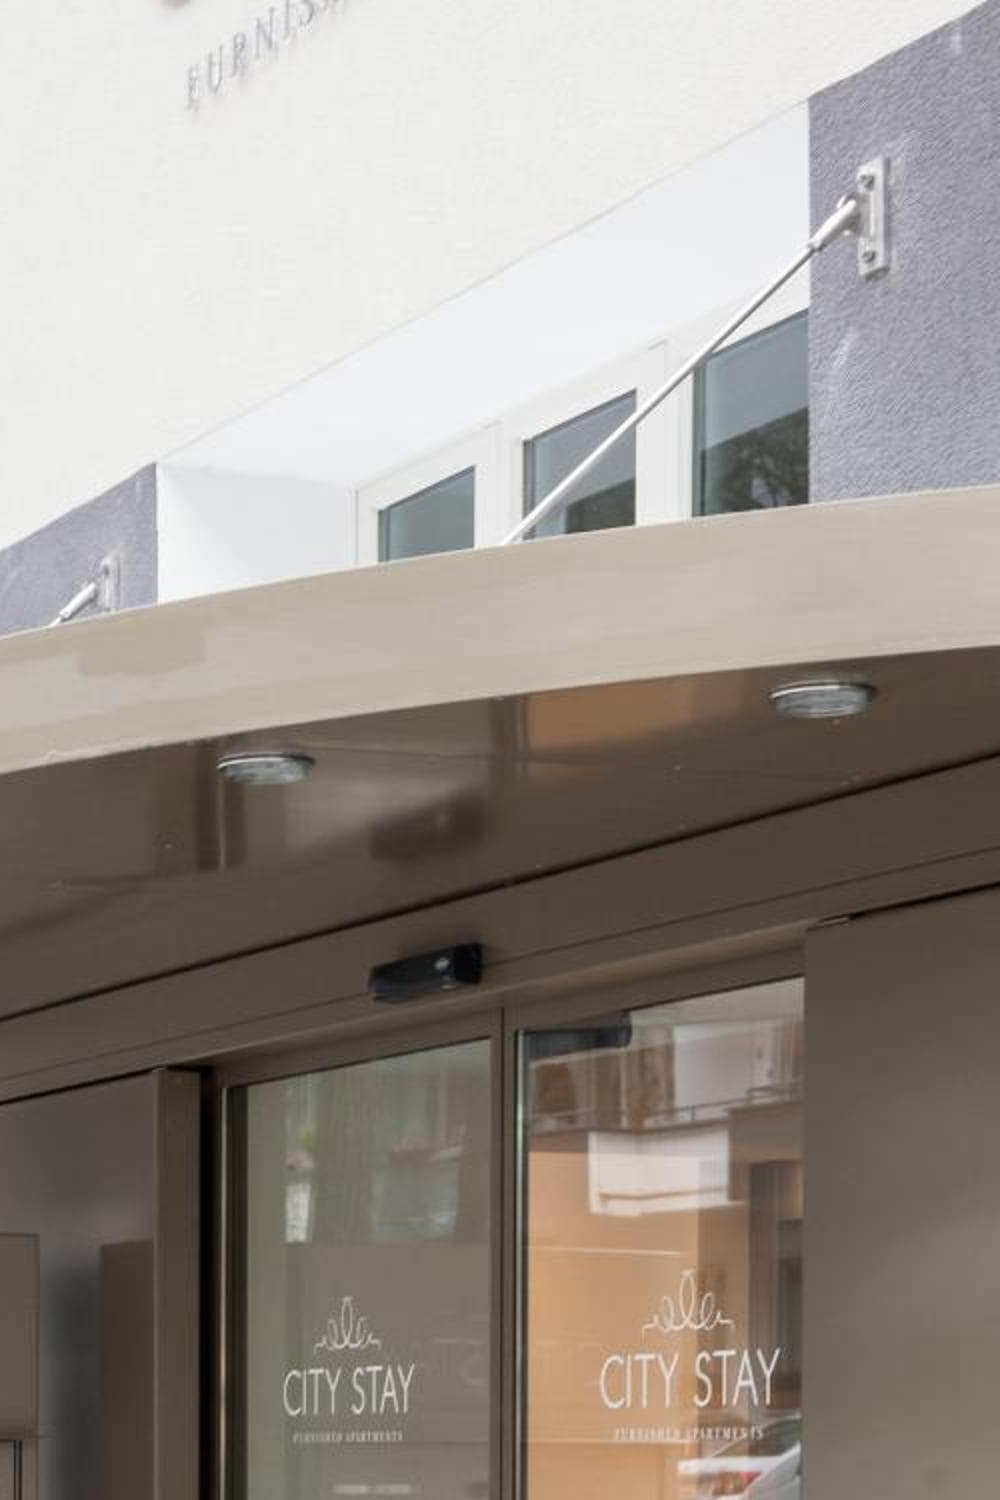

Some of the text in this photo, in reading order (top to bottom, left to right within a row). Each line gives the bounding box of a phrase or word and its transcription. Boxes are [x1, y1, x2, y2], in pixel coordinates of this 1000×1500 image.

[186, 0, 340, 110] FURNIS
[283, 1363, 415, 1417] CITY STAY
[600, 1347, 781, 1409] CITY STAY
